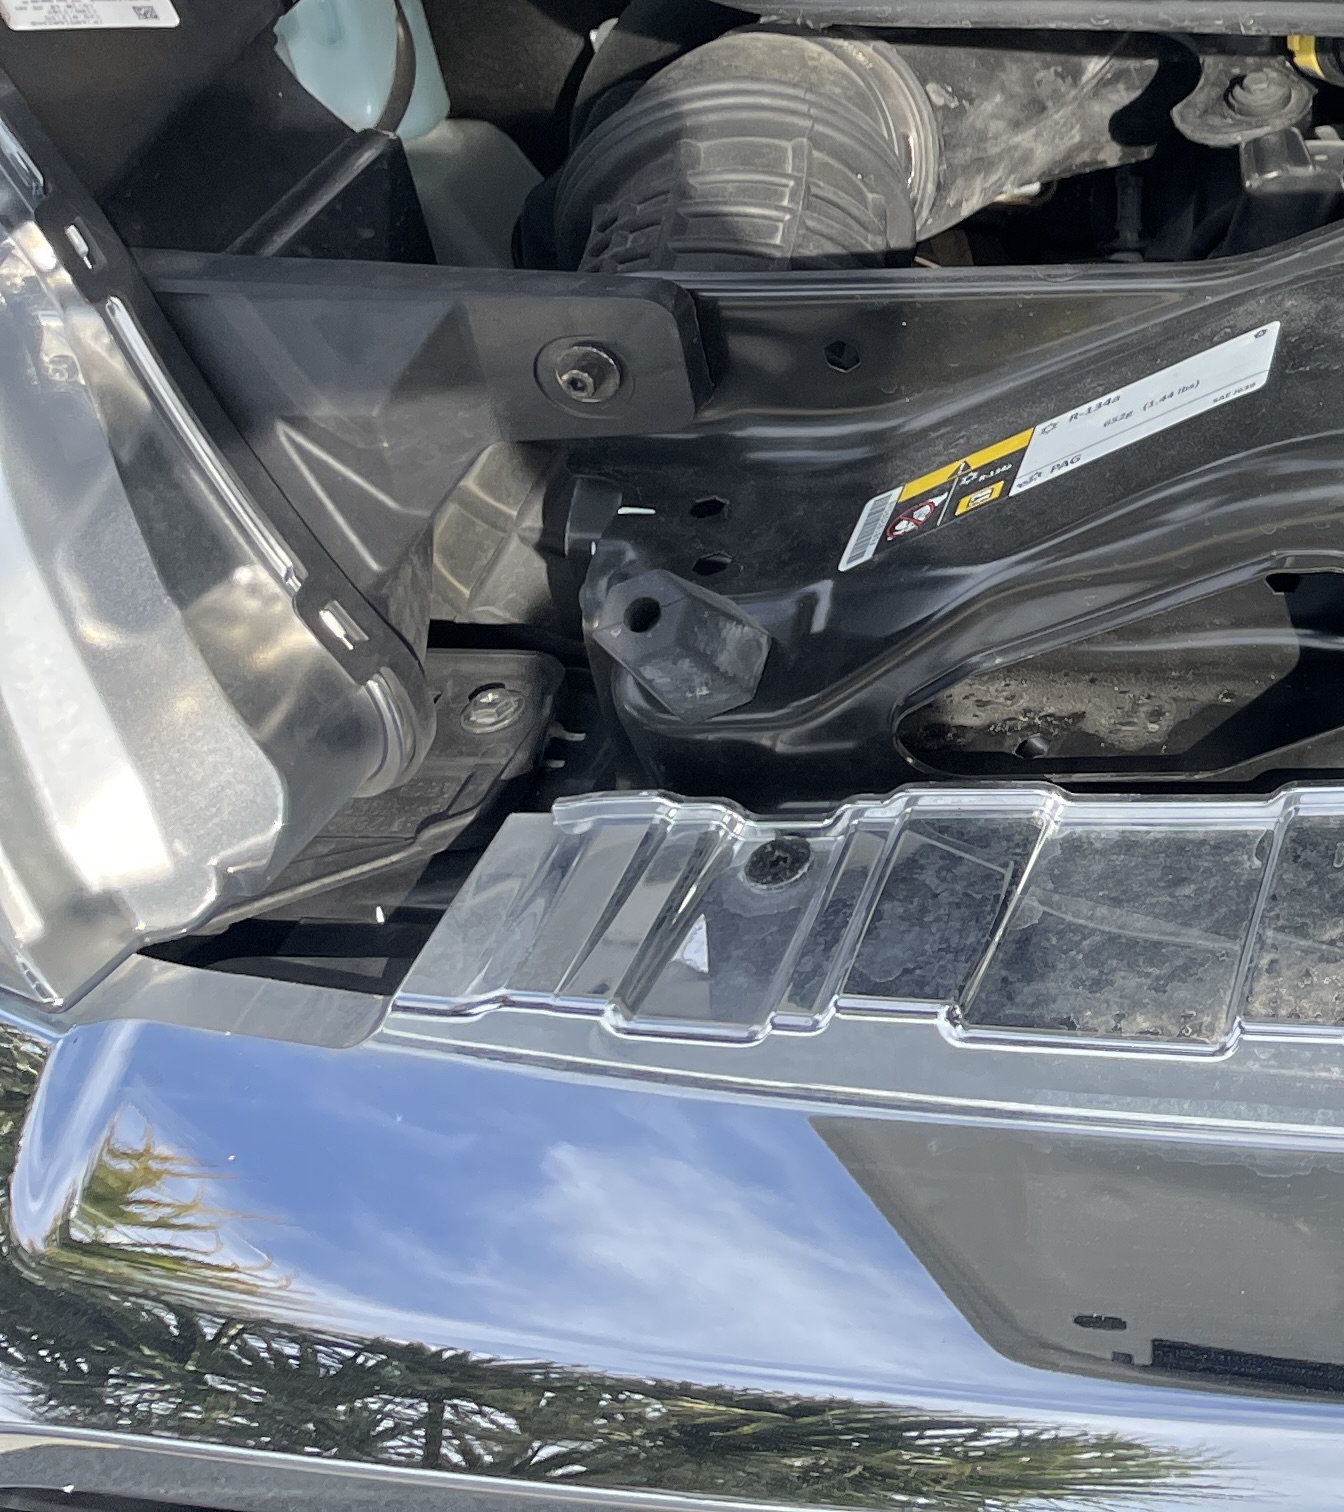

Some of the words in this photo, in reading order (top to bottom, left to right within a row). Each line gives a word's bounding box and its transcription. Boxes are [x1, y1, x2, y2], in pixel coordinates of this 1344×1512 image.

[1177, 378, 1201, 397] lbs)
[1068, 394, 1121, 423] R-134a
[1050, 454, 1082, 474] PAG
